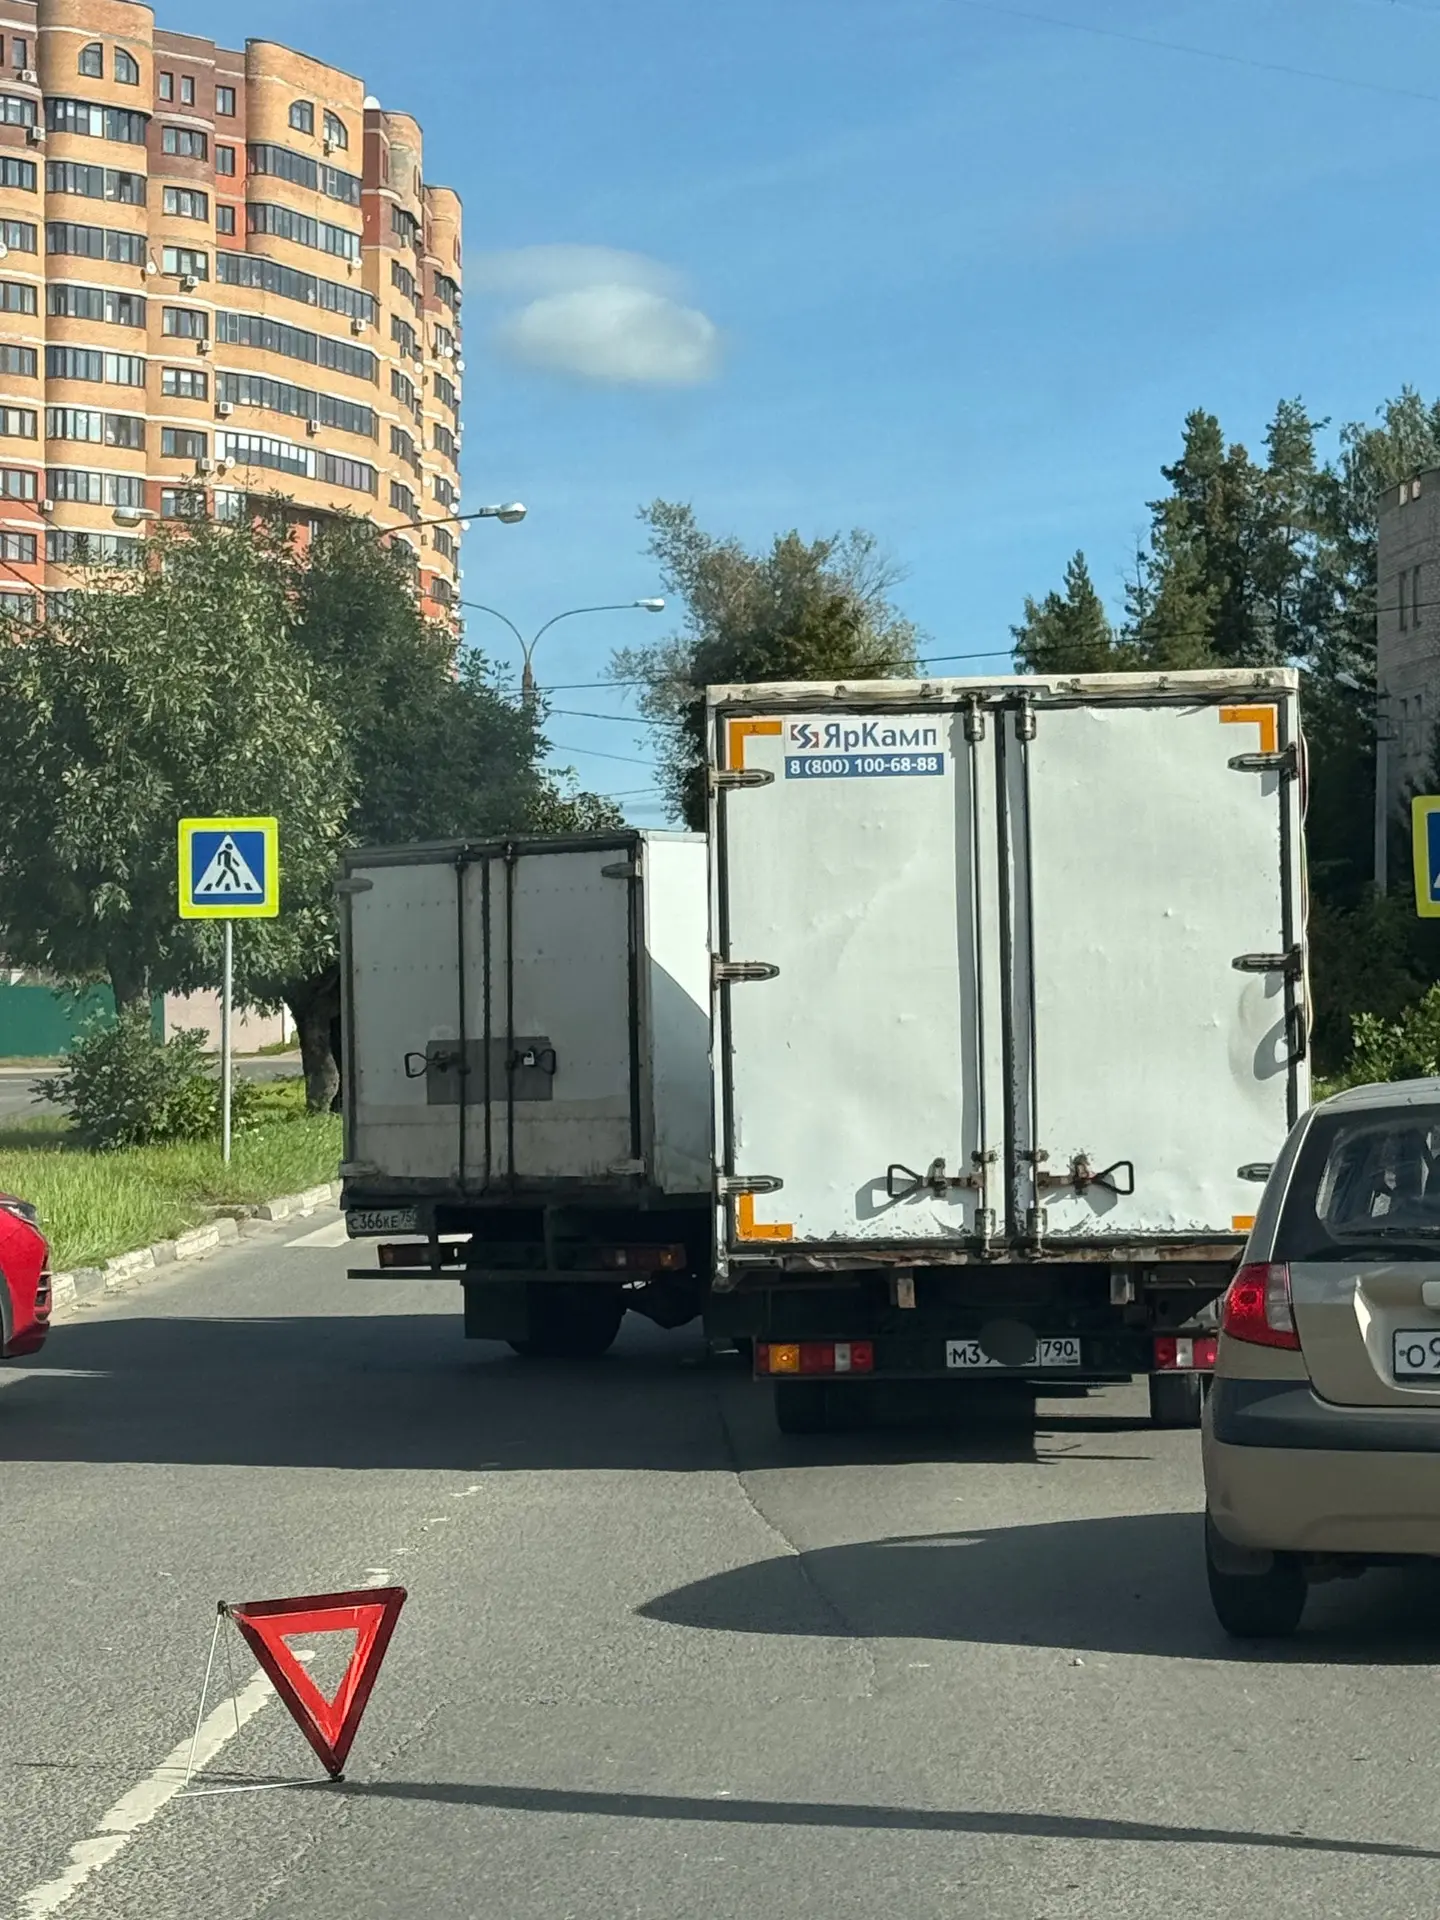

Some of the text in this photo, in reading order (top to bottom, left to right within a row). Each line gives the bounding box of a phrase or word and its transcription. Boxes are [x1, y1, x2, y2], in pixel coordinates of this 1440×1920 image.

[823, 722, 937, 752] ЯрКамп
[790, 757, 938, 775] 8 (800) 100-68-88
[1041, 1340, 1075, 1357] 790
